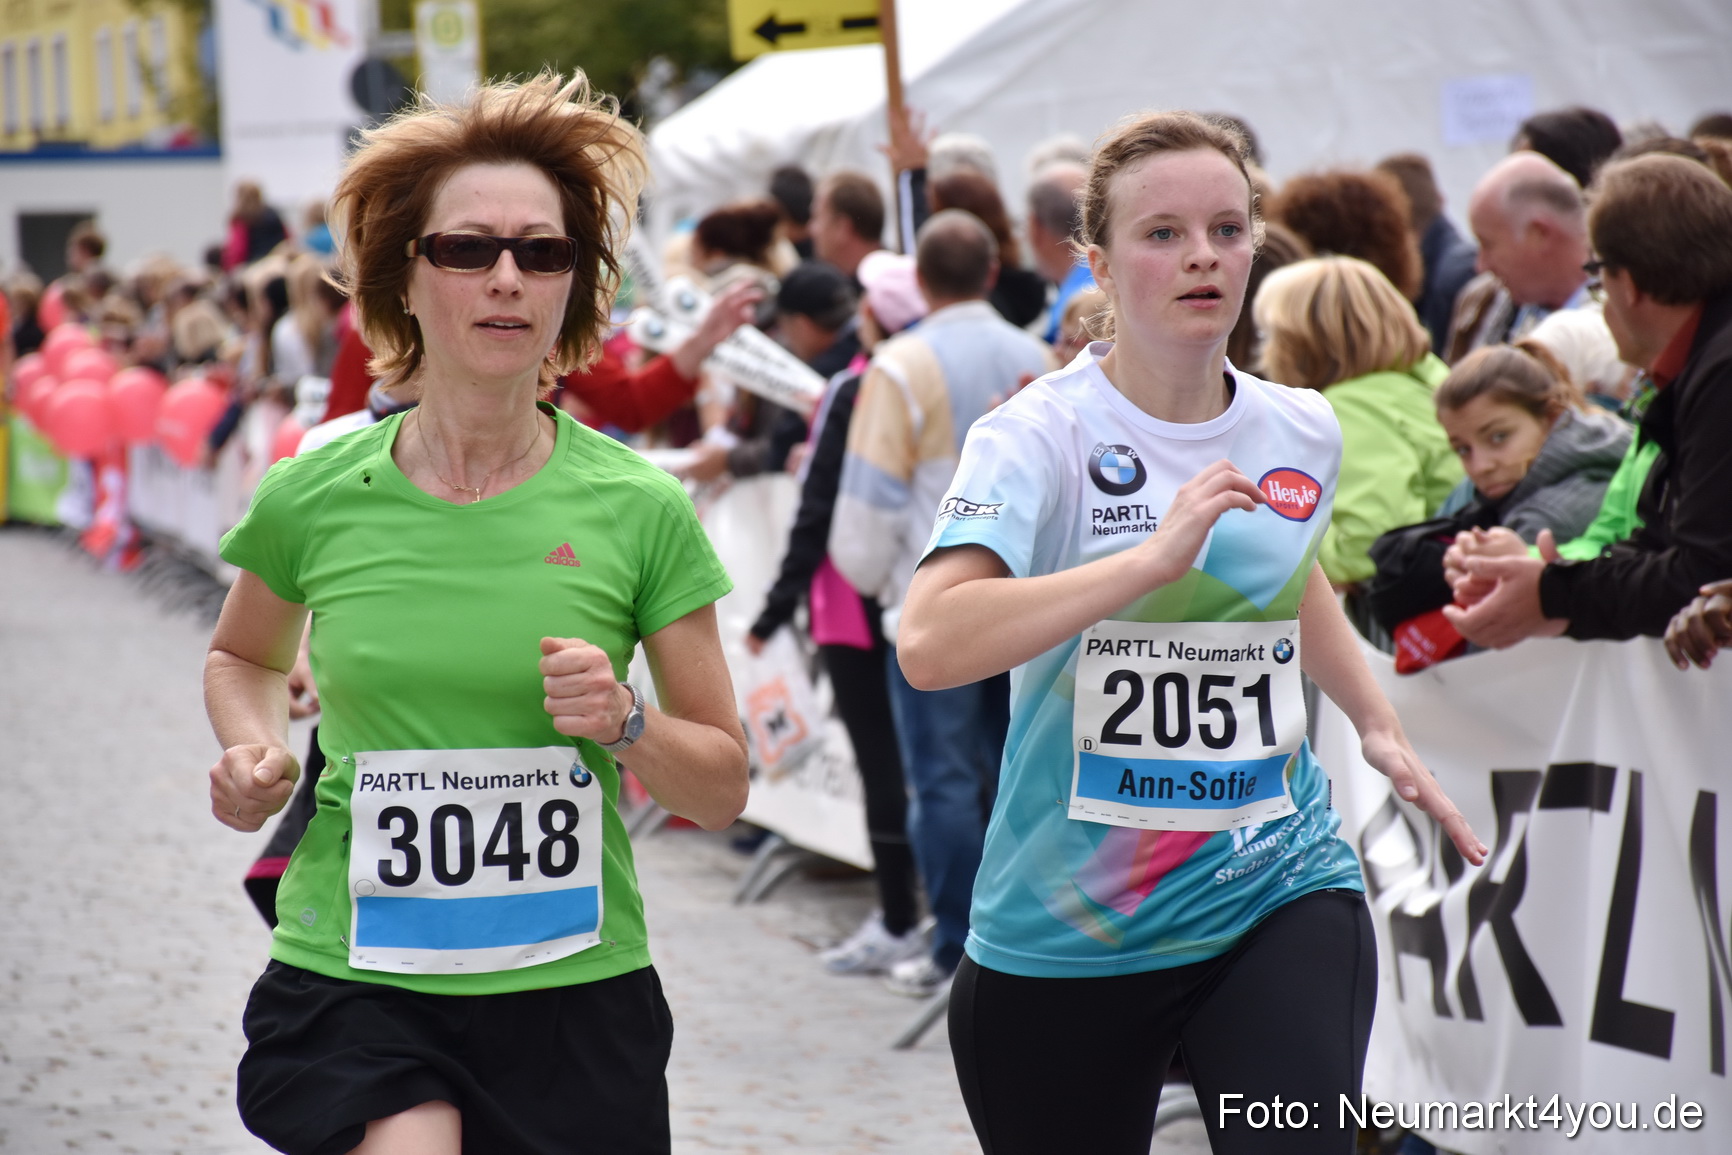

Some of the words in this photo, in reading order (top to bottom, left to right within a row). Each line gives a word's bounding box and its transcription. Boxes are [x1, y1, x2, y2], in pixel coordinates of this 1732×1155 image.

[1092, 445, 1139, 461] BMW
[1267, 480, 1318, 508] Hervis
[1092, 505, 1157, 523] PARTL
[1092, 521, 1158, 536] Neumarkt
[544, 555, 581, 567] adidas
[1086, 638, 1161, 658] PARTL
[1167, 641, 1265, 662] Neumarkt
[1100, 669, 1278, 750] 2051
[1083, 739, 1092, 751] D
[359, 771, 435, 792] PARTL
[442, 769, 559, 790] Neumarkt
[1117, 769, 1258, 801] Ann-Sofie
[377, 798, 580, 887] 3048
